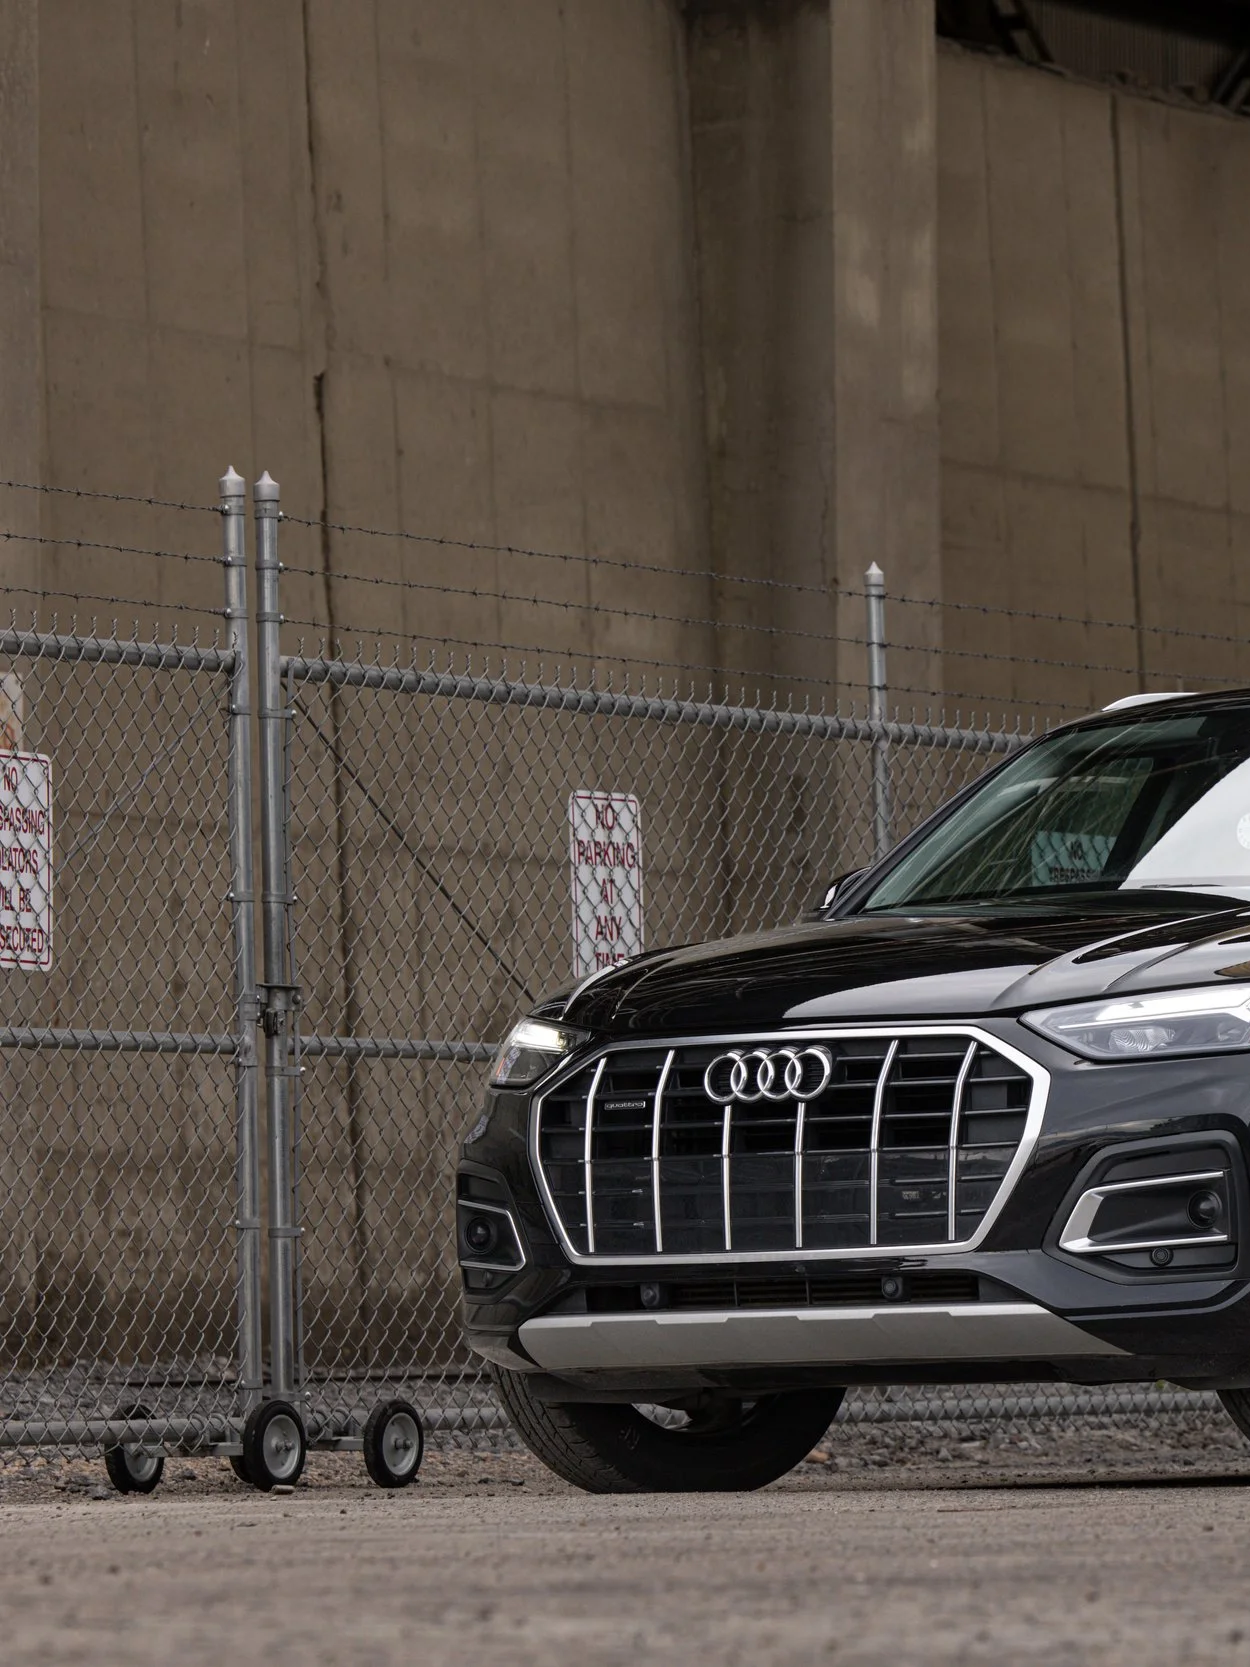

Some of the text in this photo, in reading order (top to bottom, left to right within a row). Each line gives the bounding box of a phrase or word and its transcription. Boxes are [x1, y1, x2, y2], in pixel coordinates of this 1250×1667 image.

[4, 767, 18, 792] NO
[595, 803, 615, 830] NO
[0, 847, 39, 875] LATORS
[578, 839, 635, 868] PARKING
[600, 878, 615, 905] AT
[595, 915, 622, 941] ANY
[606, 1101, 644, 1110] quattro
